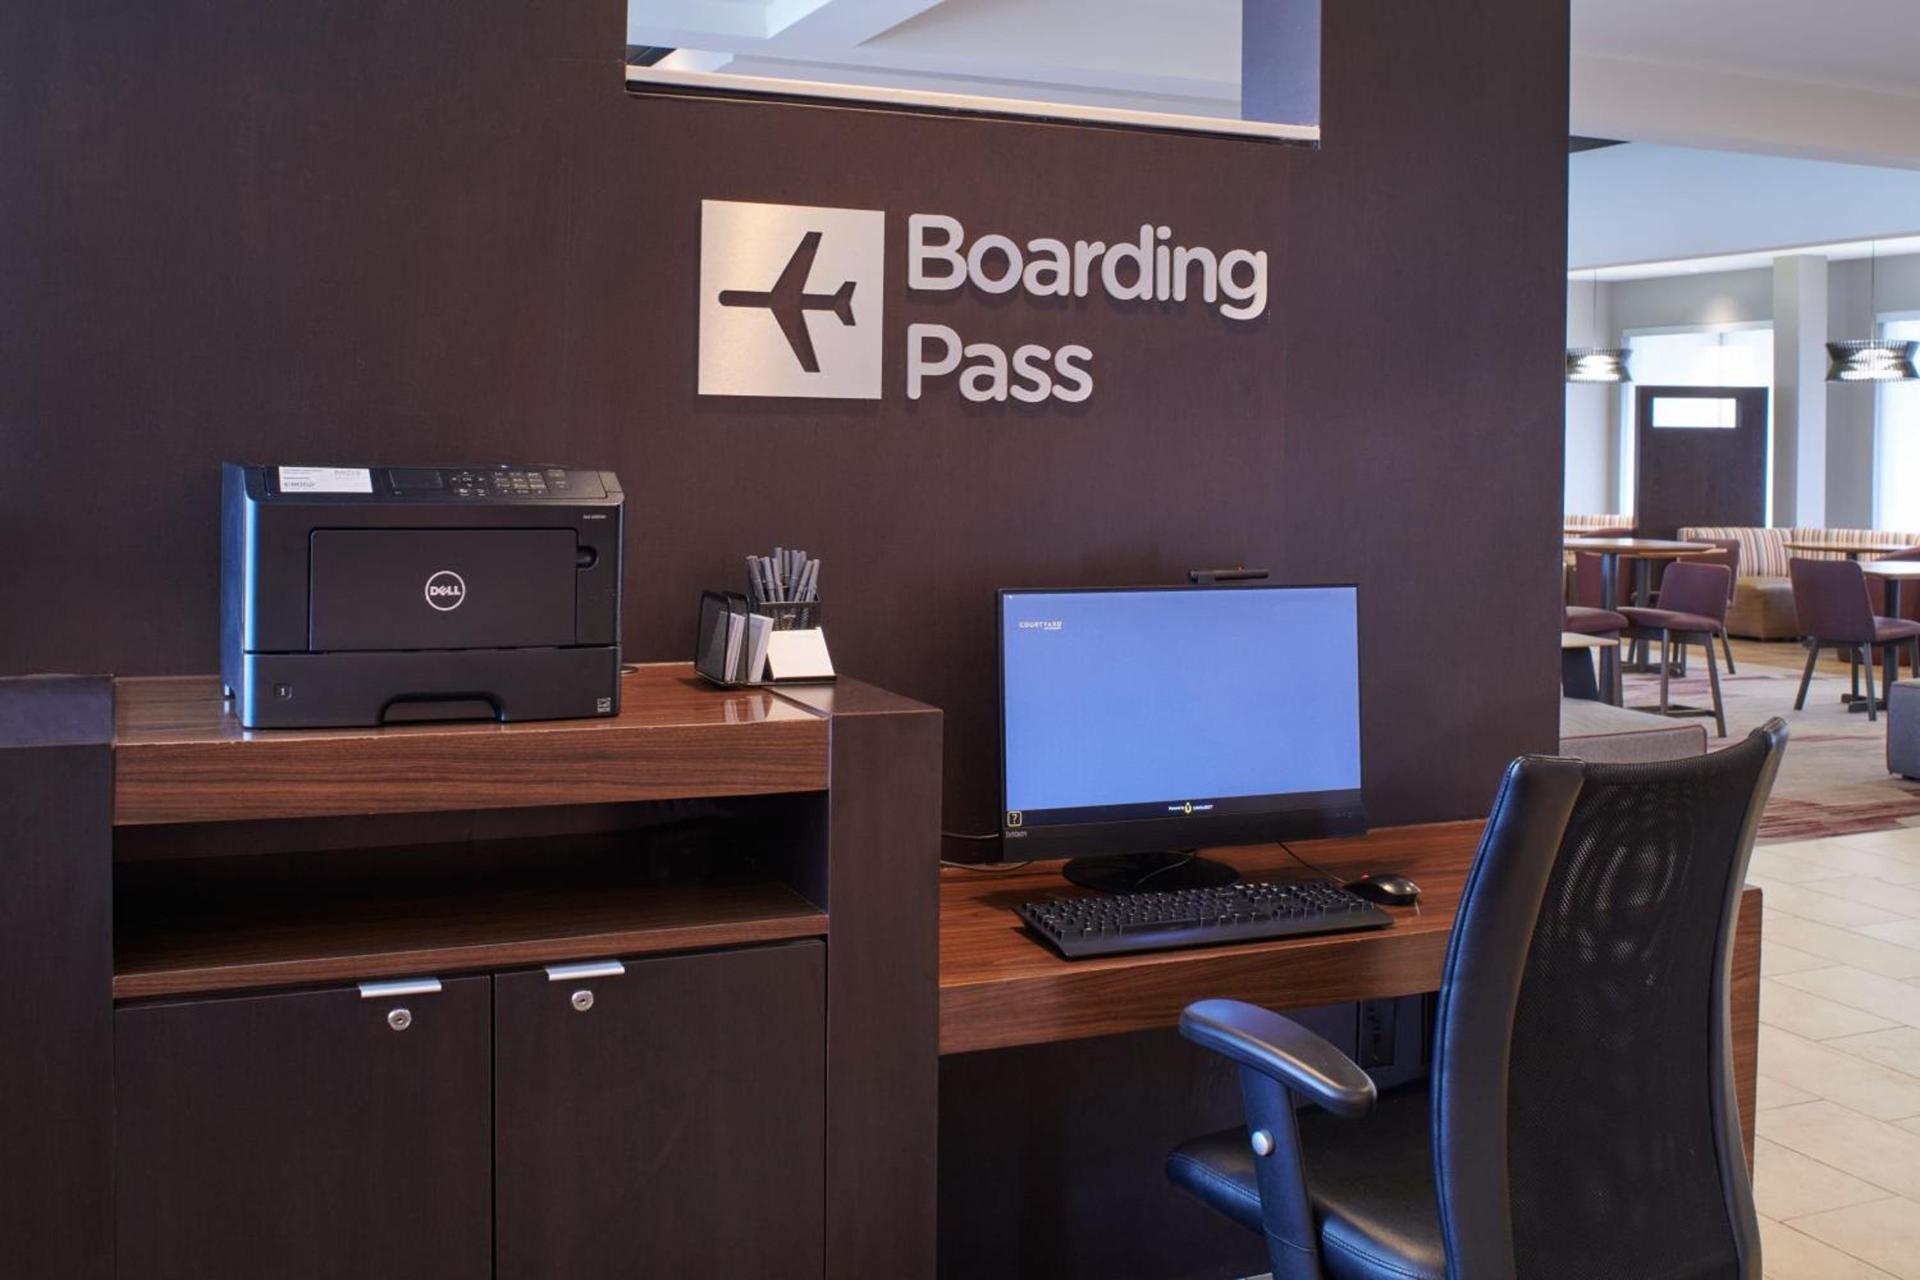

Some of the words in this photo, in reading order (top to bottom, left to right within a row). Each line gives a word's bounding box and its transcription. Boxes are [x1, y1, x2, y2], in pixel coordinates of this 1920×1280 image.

[907, 213, 1268, 320] Boarding
[907, 323, 1093, 402] Pass
[430, 585, 461, 596] DELL
